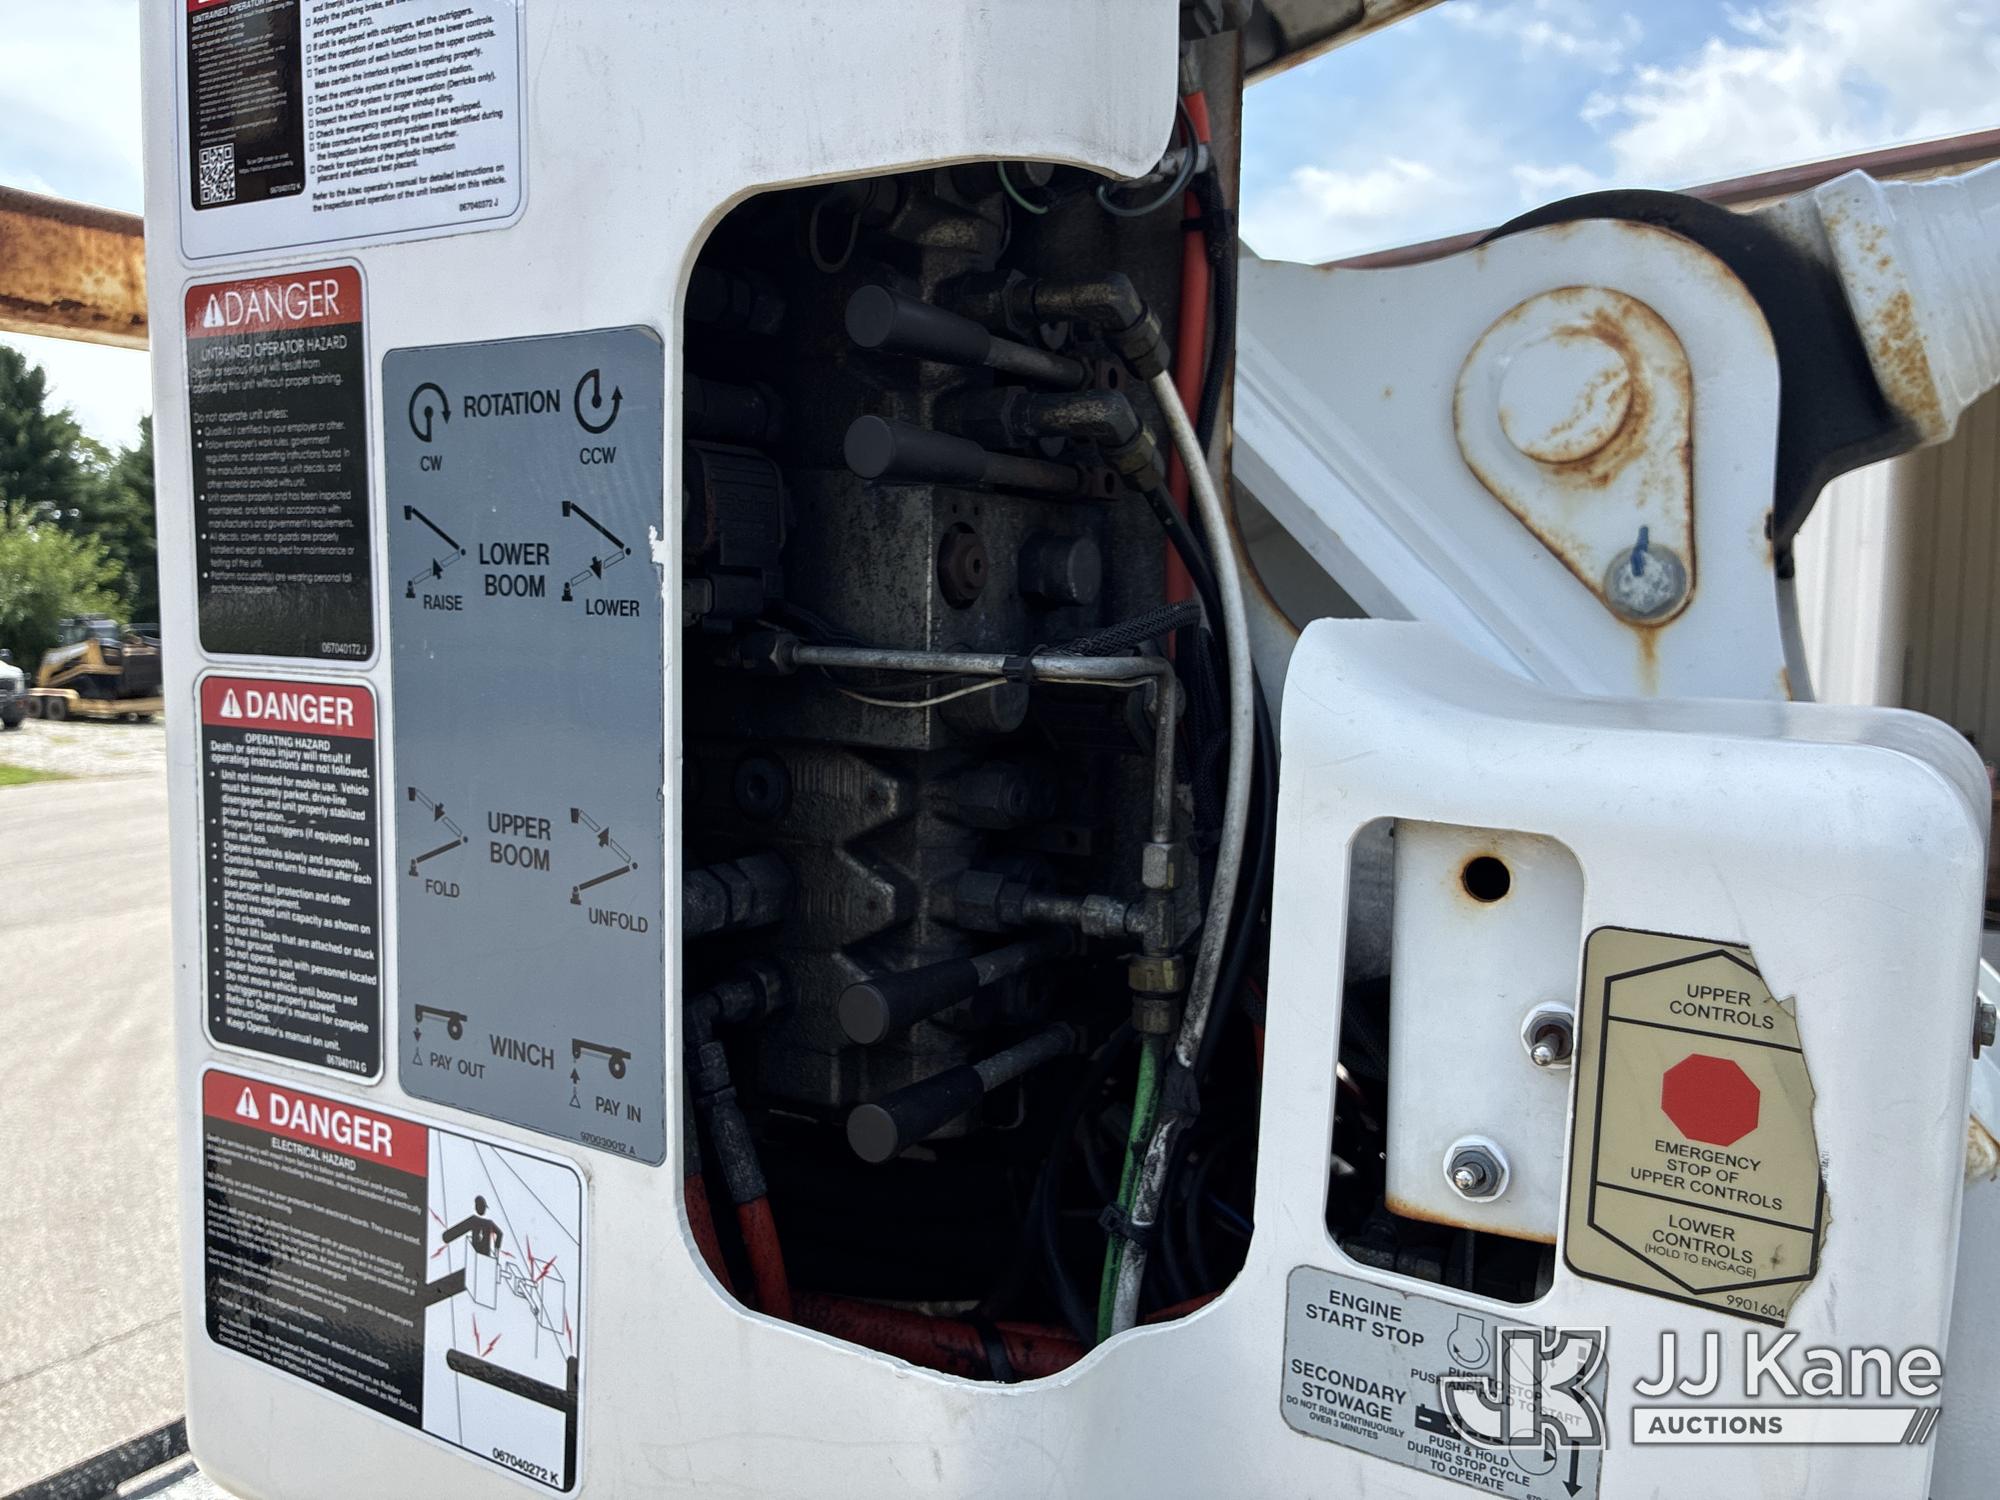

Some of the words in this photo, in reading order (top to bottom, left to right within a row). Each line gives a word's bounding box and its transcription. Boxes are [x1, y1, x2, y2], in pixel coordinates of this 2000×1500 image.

[225, 278, 340, 326] DANGER
[202, 344, 250, 361] UNTRAINED
[254, 338, 304, 357] OPERATOR
[307, 334, 347, 350] HAZARD
[464, 390, 560, 418] ROTATION
[420, 456, 442, 471] CW
[580, 447, 616, 464] CCW
[479, 543, 549, 565] LOWER
[485, 574, 545, 597] BOOM
[424, 595, 462, 610] RAISE
[586, 599, 640, 617] LOWER
[246, 690, 354, 726] DANGER
[210, 740, 234, 752] Death
[235, 744, 244, 753] or
[245, 745, 276, 756] serious
[277, 748, 301, 761] injury
[302, 750, 317, 760] will
[318, 752, 343, 763] result
[344, 753, 351, 764] if
[245, 733, 293, 748] OPERATING
[295, 736, 330, 751] HAZARD
[211, 753, 249, 767] operating
[250, 757, 299, 770] instructions
[300, 762, 314, 772] are
[315, 764, 330, 773] not
[331, 764, 369, 778] followed.
[221, 769, 236, 780] Unit
[237, 772, 249, 781] not
[250, 773, 282, 785] intended
[283, 775, 294, 786] for
[294, 778, 320, 790] mobile
[321, 782, 337, 792] use.
[340, 782, 369, 796] Vehicle
[488, 811, 551, 840] UPPER
[223, 840, 252, 854] Operate
[252, 846, 283, 859] controls
[283, 850, 307, 864] slowly
[308, 854, 323, 864] and
[324, 857, 361, 871] smoothly.
[490, 842, 550, 871] BOOM
[426, 879, 460, 898] FOLD
[589, 907, 648, 933] UNFOLD
[1686, 984, 1751, 1006] UPPER
[1670, 1000, 1774, 1030] CONTROLS
[430, 1052, 451, 1071] PAY
[458, 1059, 485, 1080] OUT
[490, 1034, 554, 1070] WINCH
[361, 1062, 367, 1072] G
[595, 1096, 620, 1116] PAY
[628, 1104, 642, 1122] IN
[270, 1092, 392, 1158] DANGER
[271, 1137, 320, 1160] ELECTRICAL
[322, 1152, 356, 1171] HAZARD
[1655, 1139, 1761, 1172] EMERGENCY
[1667, 1158, 1712, 1179] STOP
[1716, 1170, 1739, 1184] OF
[1630, 1167, 1685, 1188] UPPER
[1690, 1180, 1783, 1211] CONTROLS
[1669, 1214, 1735, 1241] LOWER
[1652, 1229, 1753, 1264] CONTROLS
[1644, 1242, 1682, 1261] (HOLD
[1684, 1252, 1699, 1264] TO
[1701, 1254, 1757, 1280] ENGAGE)
[1329, 1289, 1402, 1322] ENGINE
[1726, 1294, 1786, 1319] 9901604
[1306, 1304, 1366, 1333] START
[1372, 1321, 1424, 1347] STOP
[1291, 1358, 1407, 1405] SECONDARY
[1301, 1382, 1392, 1422] STOWAGE
[1286, 1395, 1298, 1405] DO
[1300, 1399, 1317, 1411] NOT
[1319, 1404, 1337, 1417] RUN
[1339, 1411, 1405, 1438] CONTINUOUSLY
[1309, 1412, 1332, 1425] OVER
[1334, 1418, 1339, 1426] 3
[1340, 1420, 1378, 1440] MINUTES
[1407, 1440, 1452, 1462] DURING
[1455, 1455, 1486, 1472] STOP
[1489, 1465, 1530, 1487] CYCLE
[1429, 1435, 1461, 1452] PUSH
[1463, 1446, 1472, 1456] &
[1476, 1448, 1509, 1468] HOLD
[550, 1472, 559, 1485] K
[1430, 1459, 1446, 1471] TO
[1450, 1465, 1504, 1492] OPERATE
